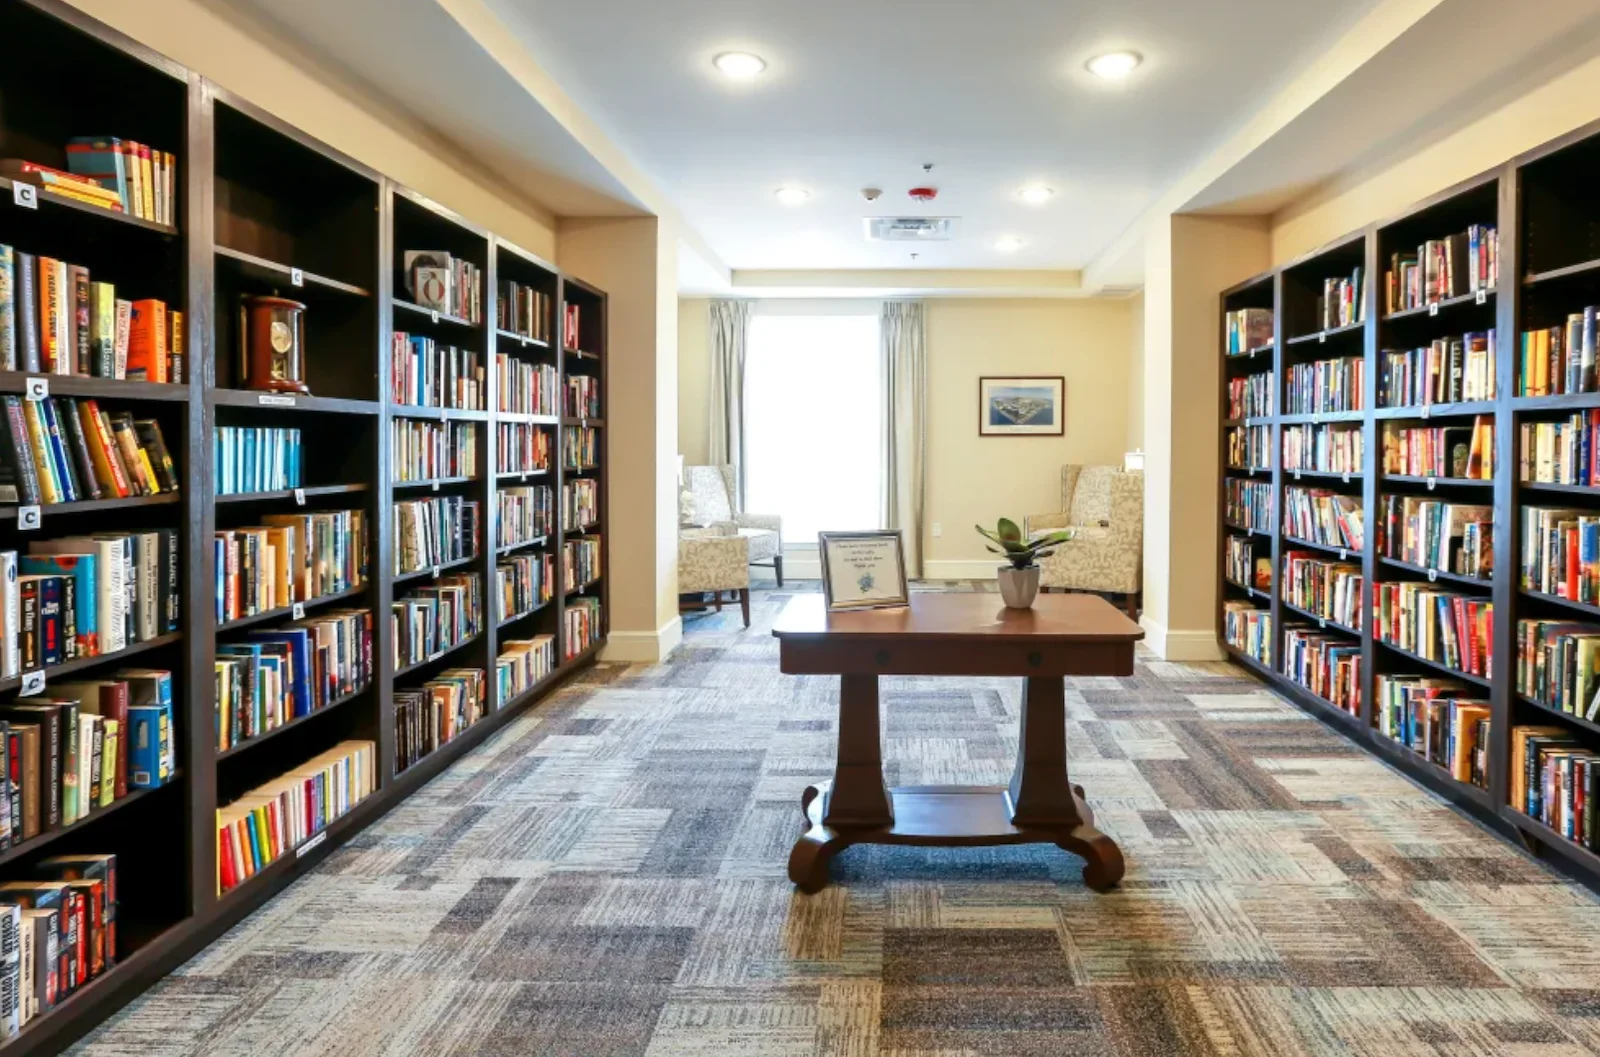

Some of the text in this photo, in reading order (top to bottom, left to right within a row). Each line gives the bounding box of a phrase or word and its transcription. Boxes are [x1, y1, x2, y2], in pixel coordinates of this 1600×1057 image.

[20, 189, 31, 201] C
[33, 383, 43, 395] C
[24, 512, 36, 524] C
[169, 534, 177, 552] TOM
[169, 554, 177, 587] CLANCY
[23, 612, 36, 632] Clancy
[27, 677, 40, 690] C
[2, 914, 13, 1019] CUSSLER ODYSSEY
